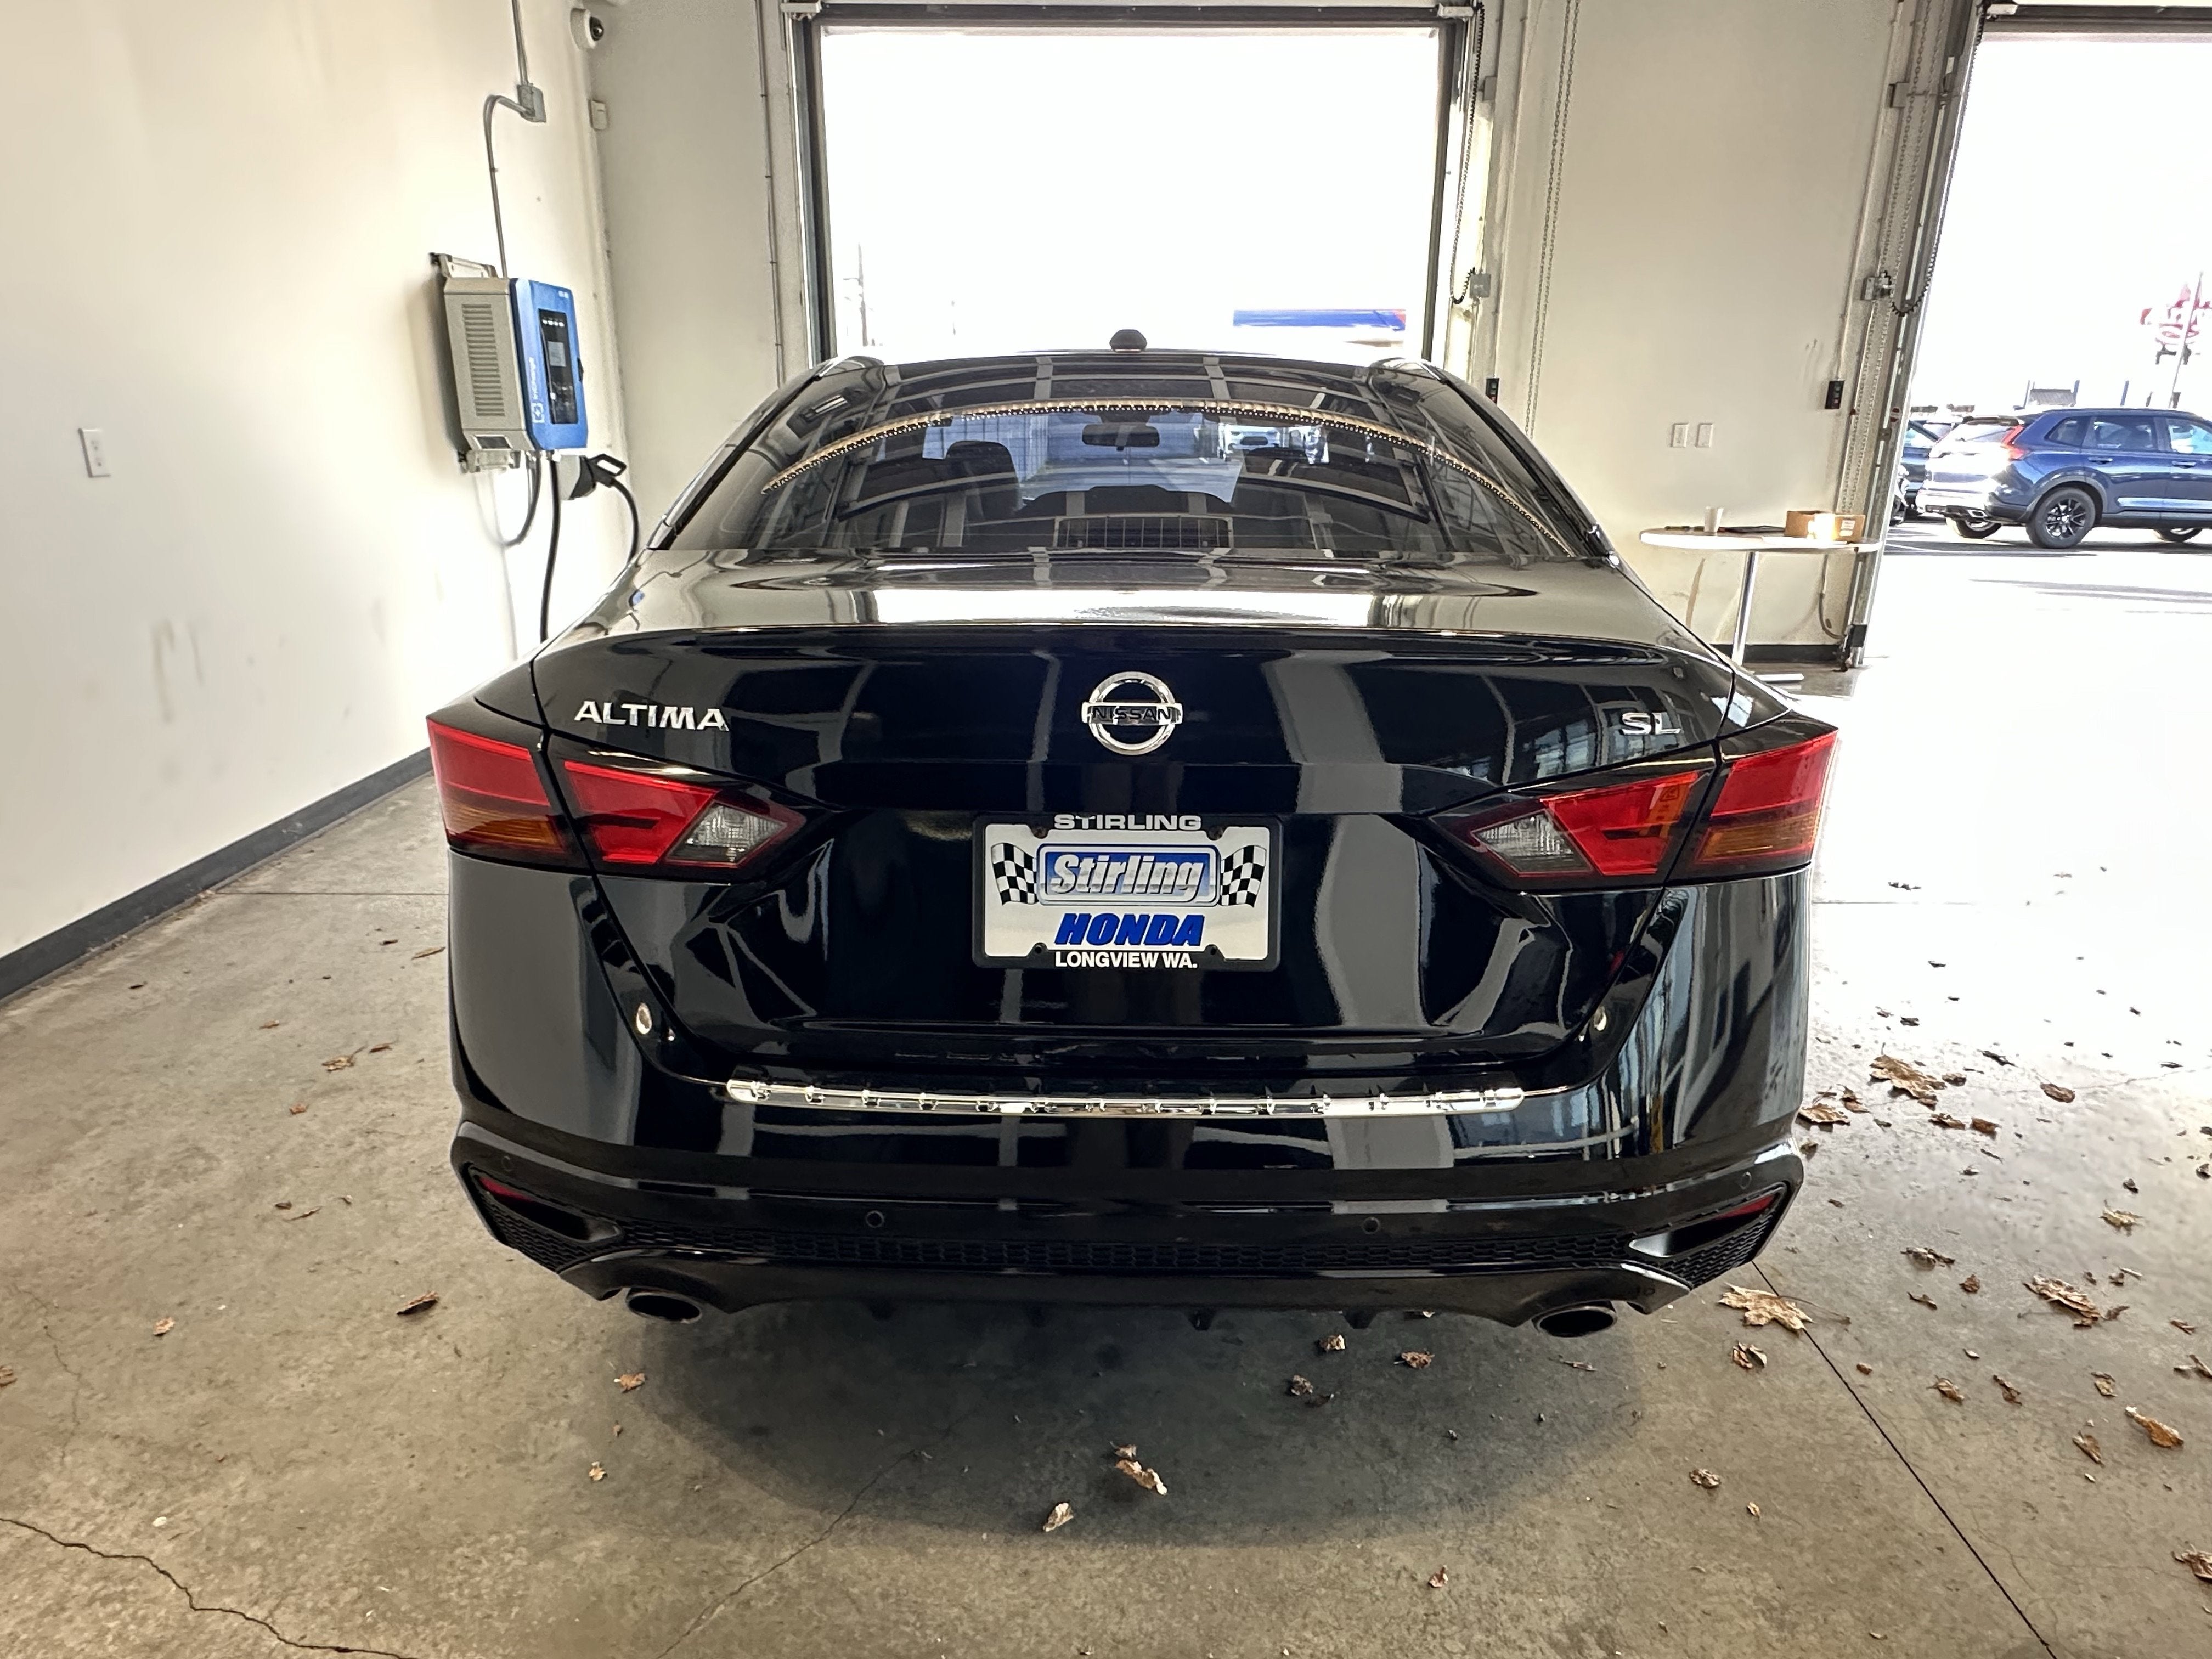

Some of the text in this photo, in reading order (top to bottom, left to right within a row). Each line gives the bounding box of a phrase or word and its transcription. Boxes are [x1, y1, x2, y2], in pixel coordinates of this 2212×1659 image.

[574, 700, 730, 732] ALTIMA
[1092, 707, 1171, 720] NISSAN
[1622, 712, 1681, 734] SL
[1054, 814, 1201, 831] STIRLING
[1050, 854, 1204, 902] Stirling
[1054, 913, 1205, 946] HONDA
[1055, 951, 1198, 969] LONGVIEW WA.
